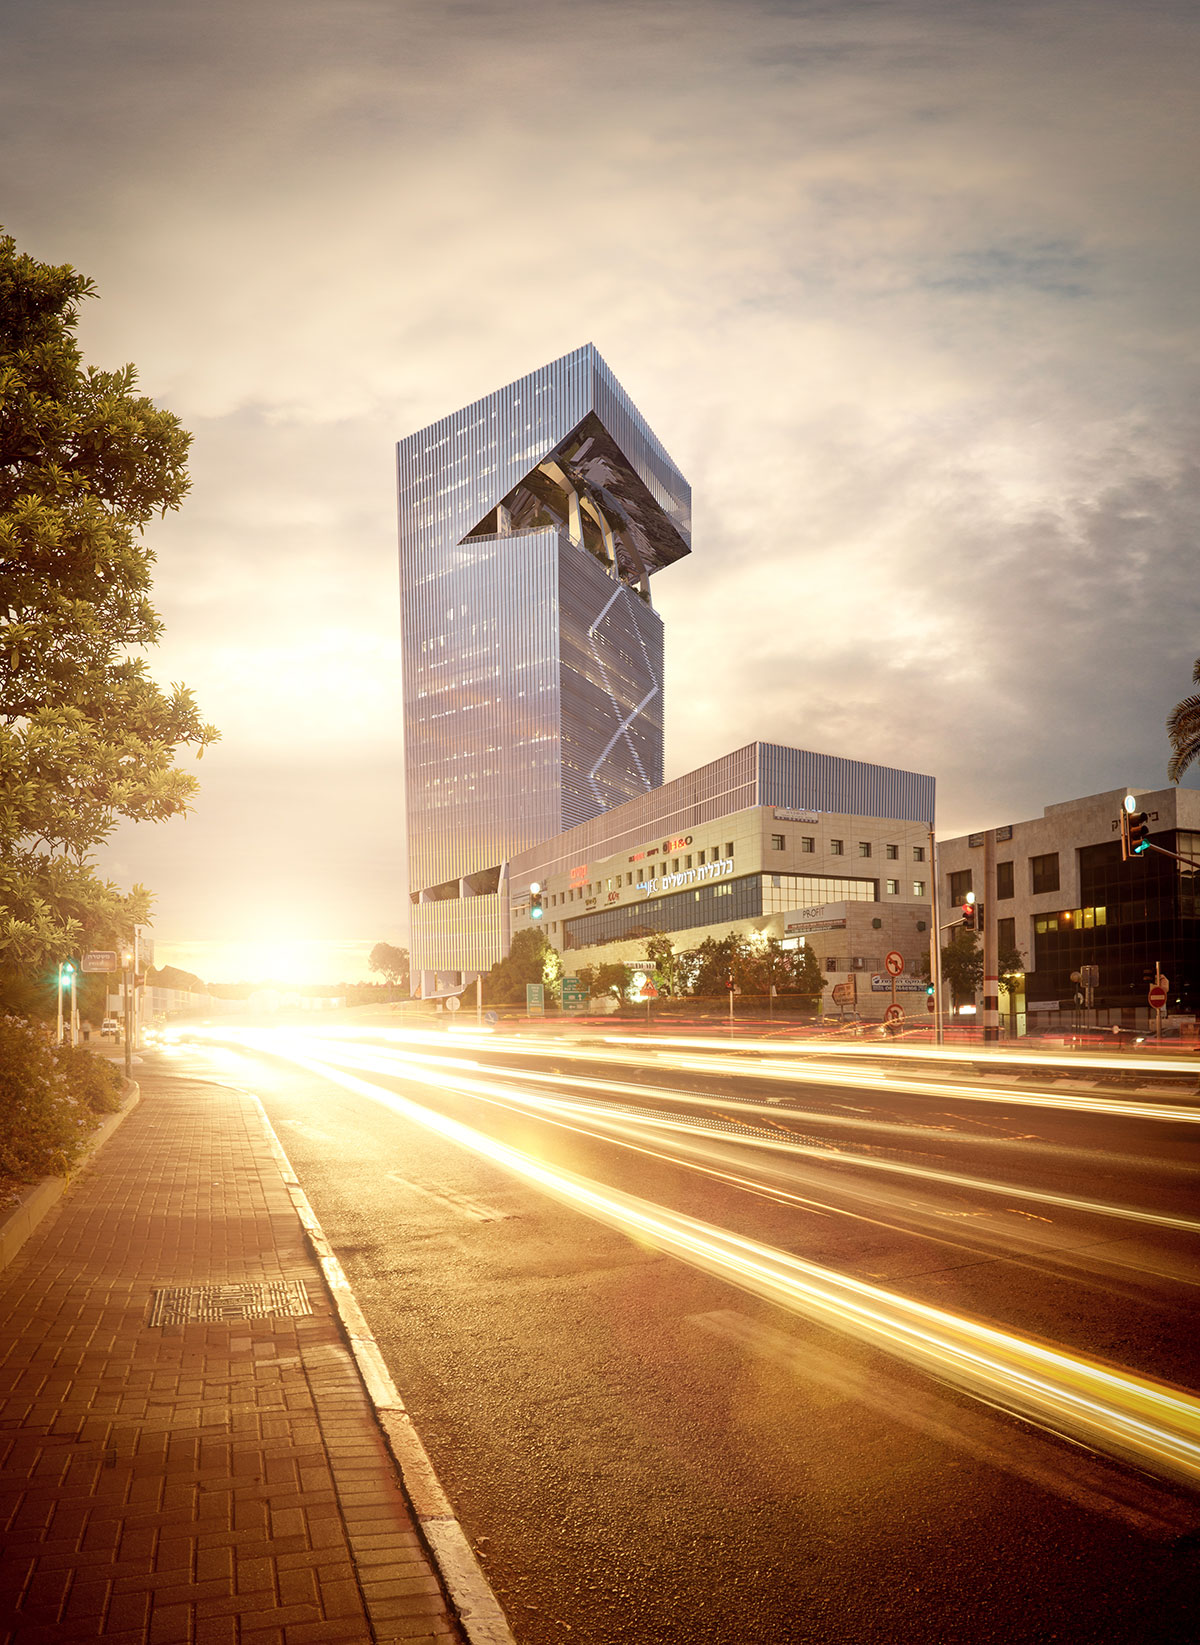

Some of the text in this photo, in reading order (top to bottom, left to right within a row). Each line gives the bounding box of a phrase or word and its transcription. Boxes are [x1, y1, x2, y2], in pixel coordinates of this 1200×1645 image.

[670, 835, 693, 851] H&O
[697, 859, 734, 881] כלכלית
[662, 870, 697, 890] ירושלים
[802, 906, 825, 919] PROFIT
